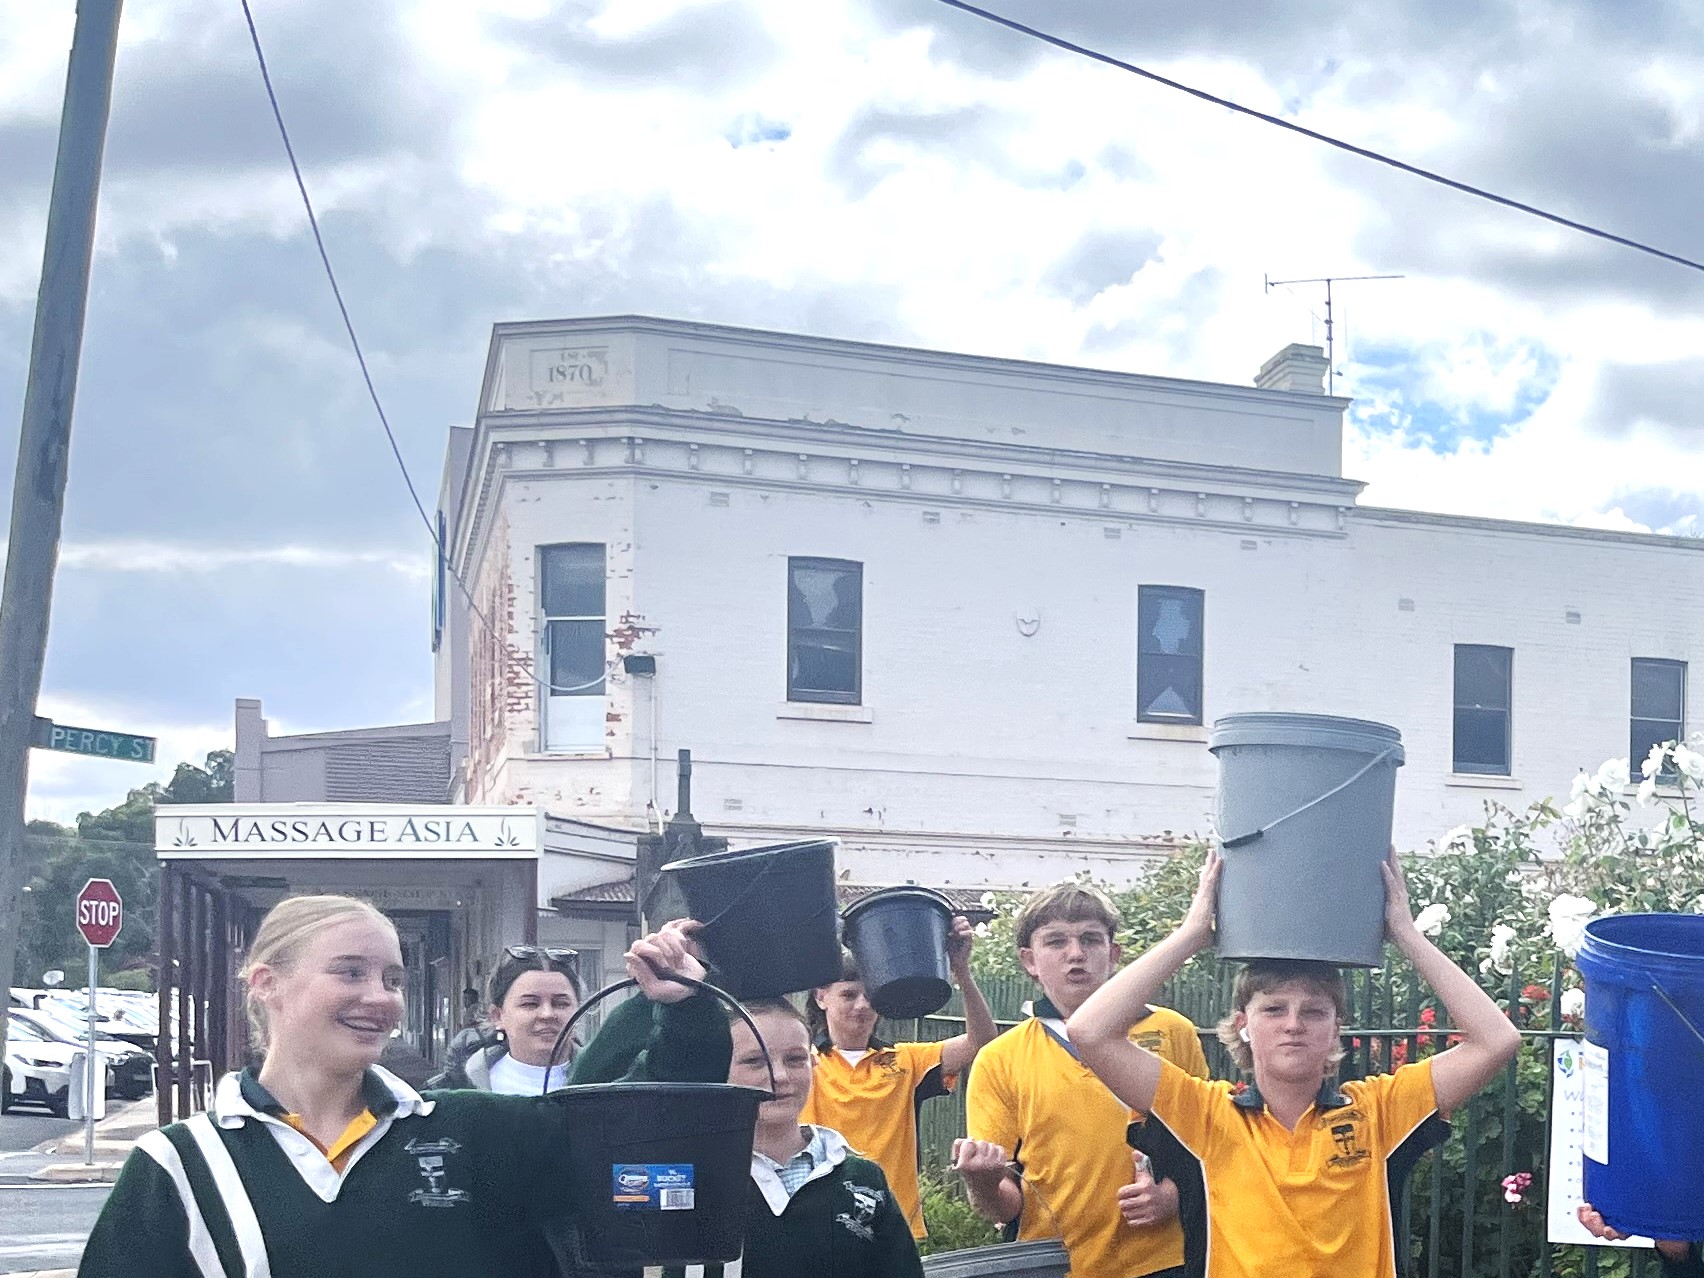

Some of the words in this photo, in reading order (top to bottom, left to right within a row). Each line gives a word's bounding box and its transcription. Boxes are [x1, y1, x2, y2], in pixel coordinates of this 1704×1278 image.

[549, 364, 593, 383] 1870
[50, 727, 124, 755] PERCY
[130, 739, 155, 760] ST
[210, 817, 388, 842] MASSAGE
[394, 816, 481, 843] ASIA
[80, 900, 119, 926] STOP
